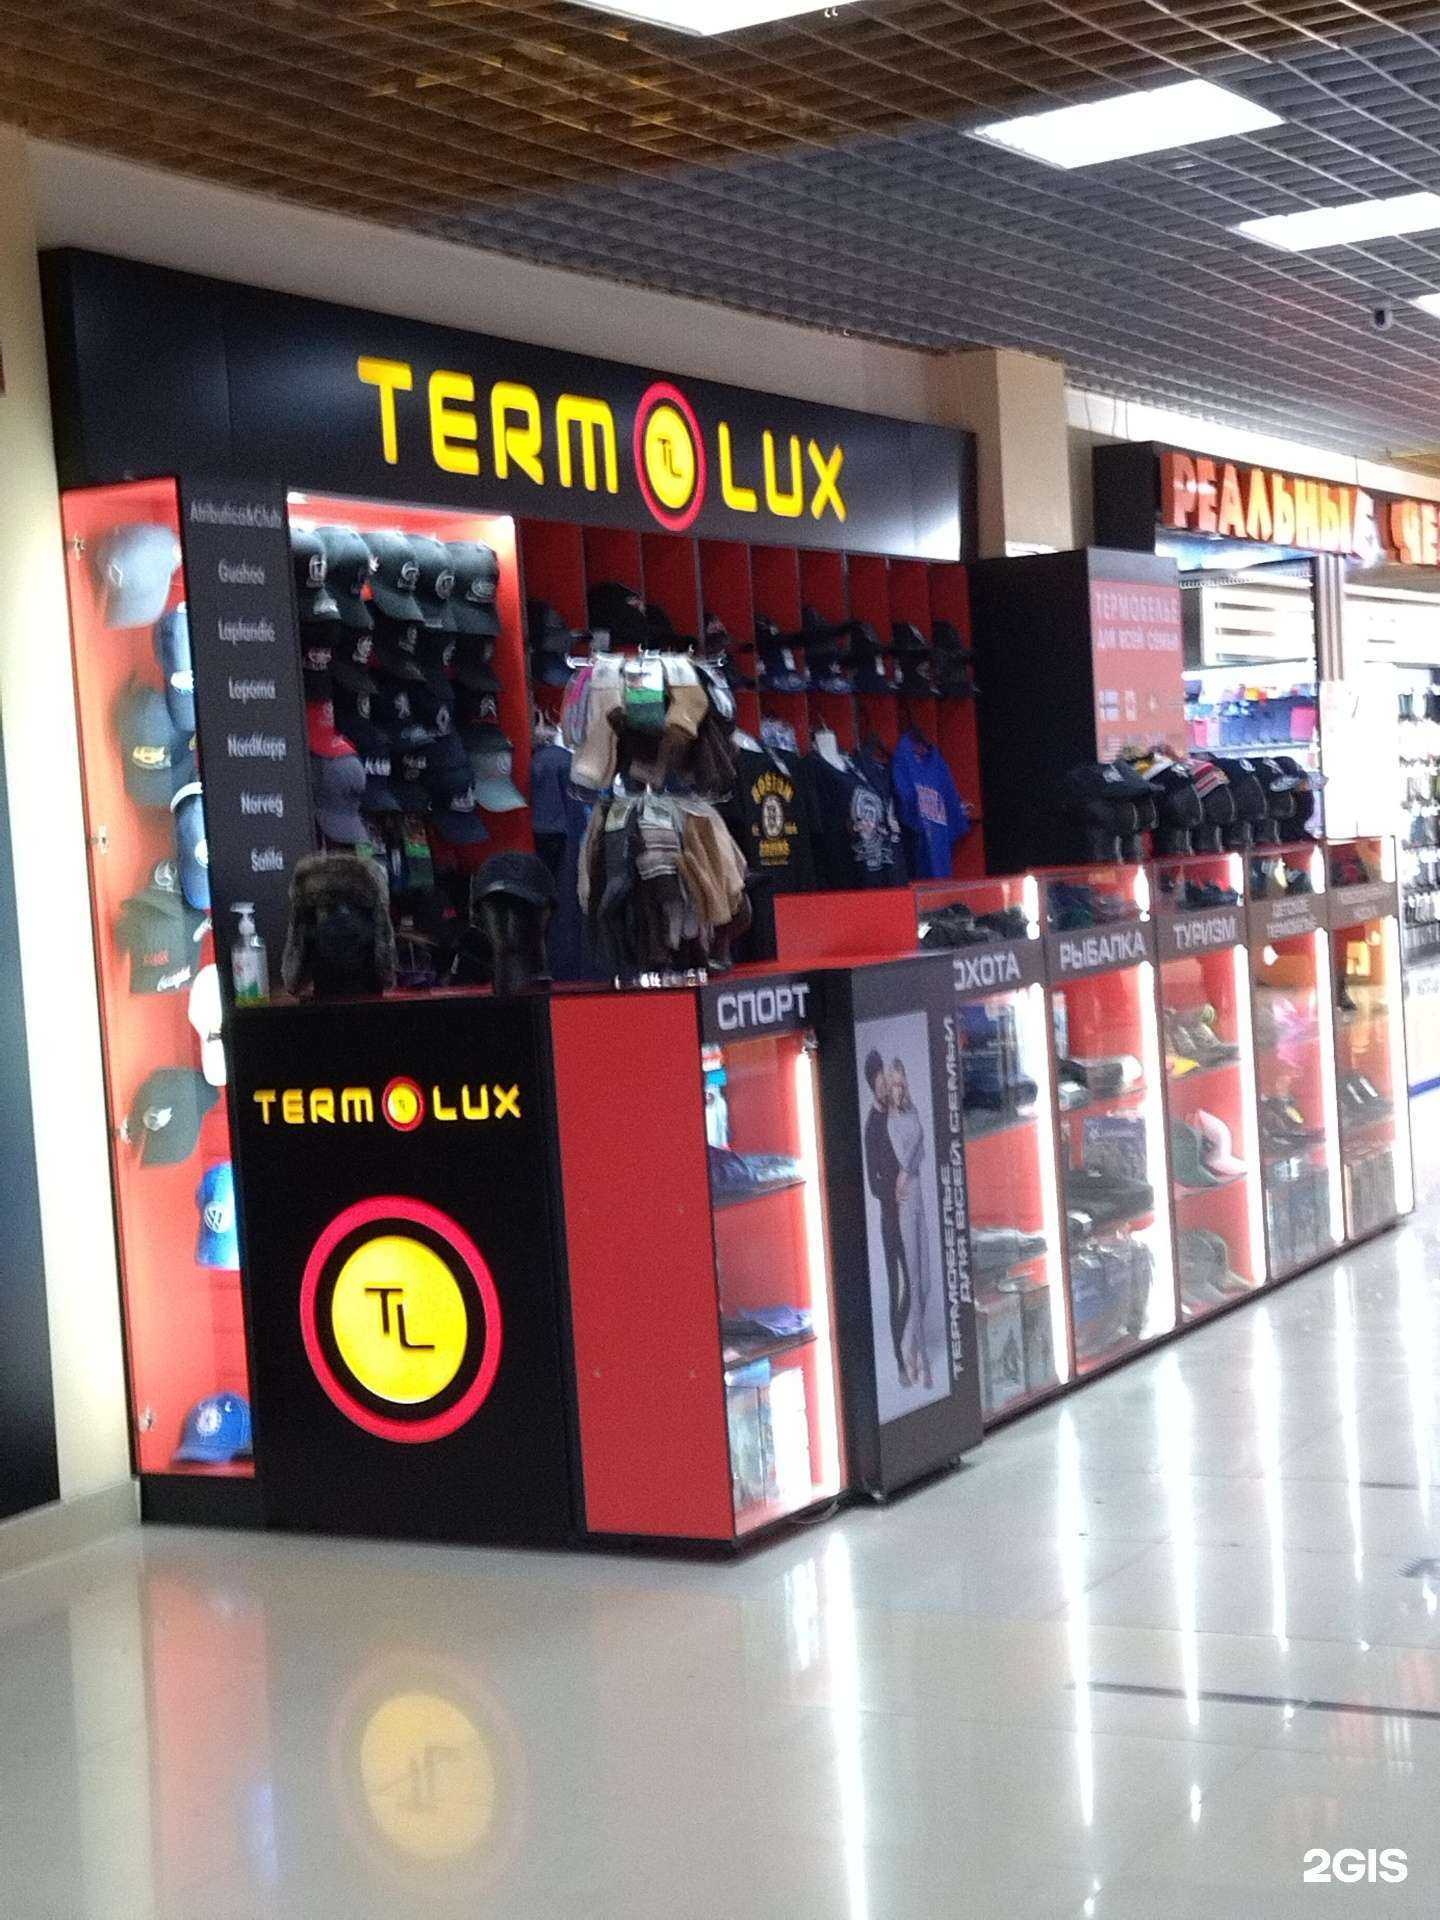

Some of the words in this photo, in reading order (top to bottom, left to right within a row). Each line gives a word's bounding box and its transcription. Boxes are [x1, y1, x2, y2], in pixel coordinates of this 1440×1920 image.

[1391, 499, 1440, 567] ЧЕ
[1059, 930, 1148, 972] РЫБАЛКА
[1172, 917, 1239, 950] ТУРИЗМ
[716, 982, 811, 1032] СПОРТ
[364, 1287, 436, 1351] TL
